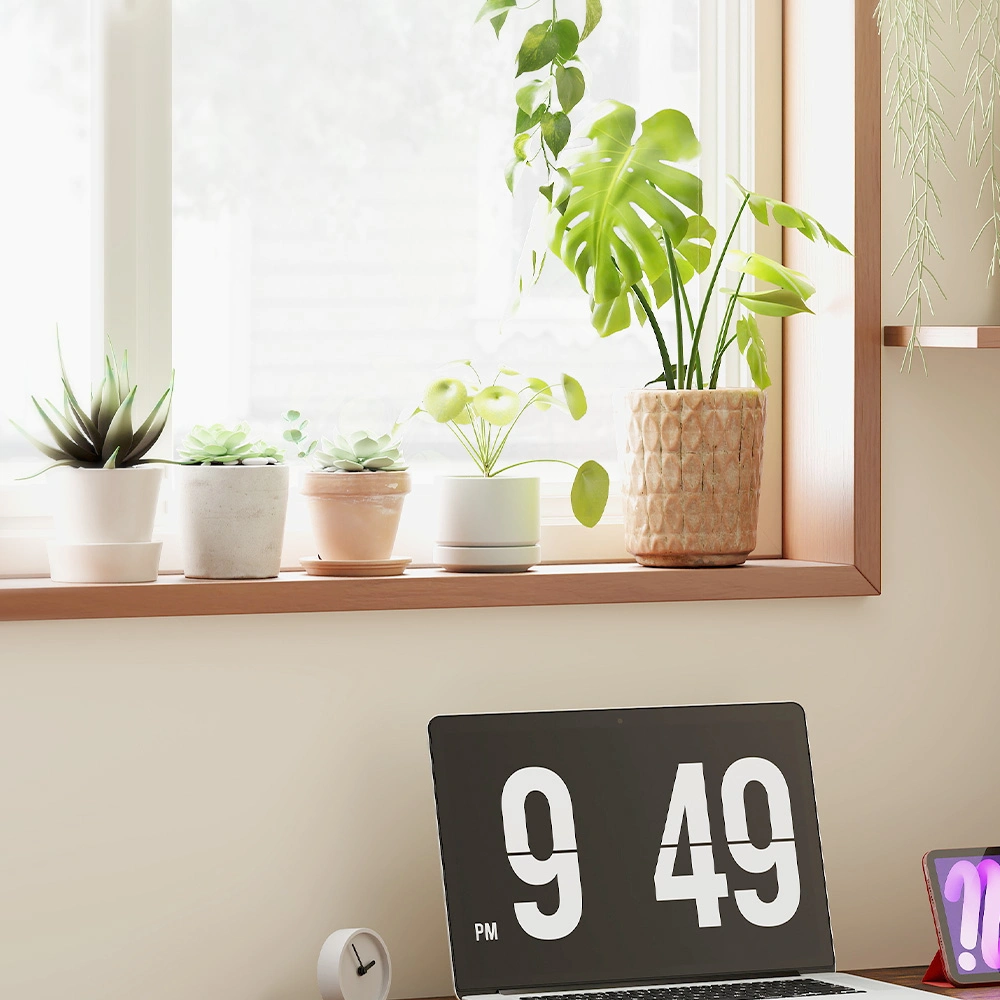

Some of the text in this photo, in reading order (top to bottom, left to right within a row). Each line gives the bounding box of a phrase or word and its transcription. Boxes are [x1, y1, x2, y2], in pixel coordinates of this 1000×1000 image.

[501, 756, 801, 941] 9 49
[474, 922, 499, 942] PM
